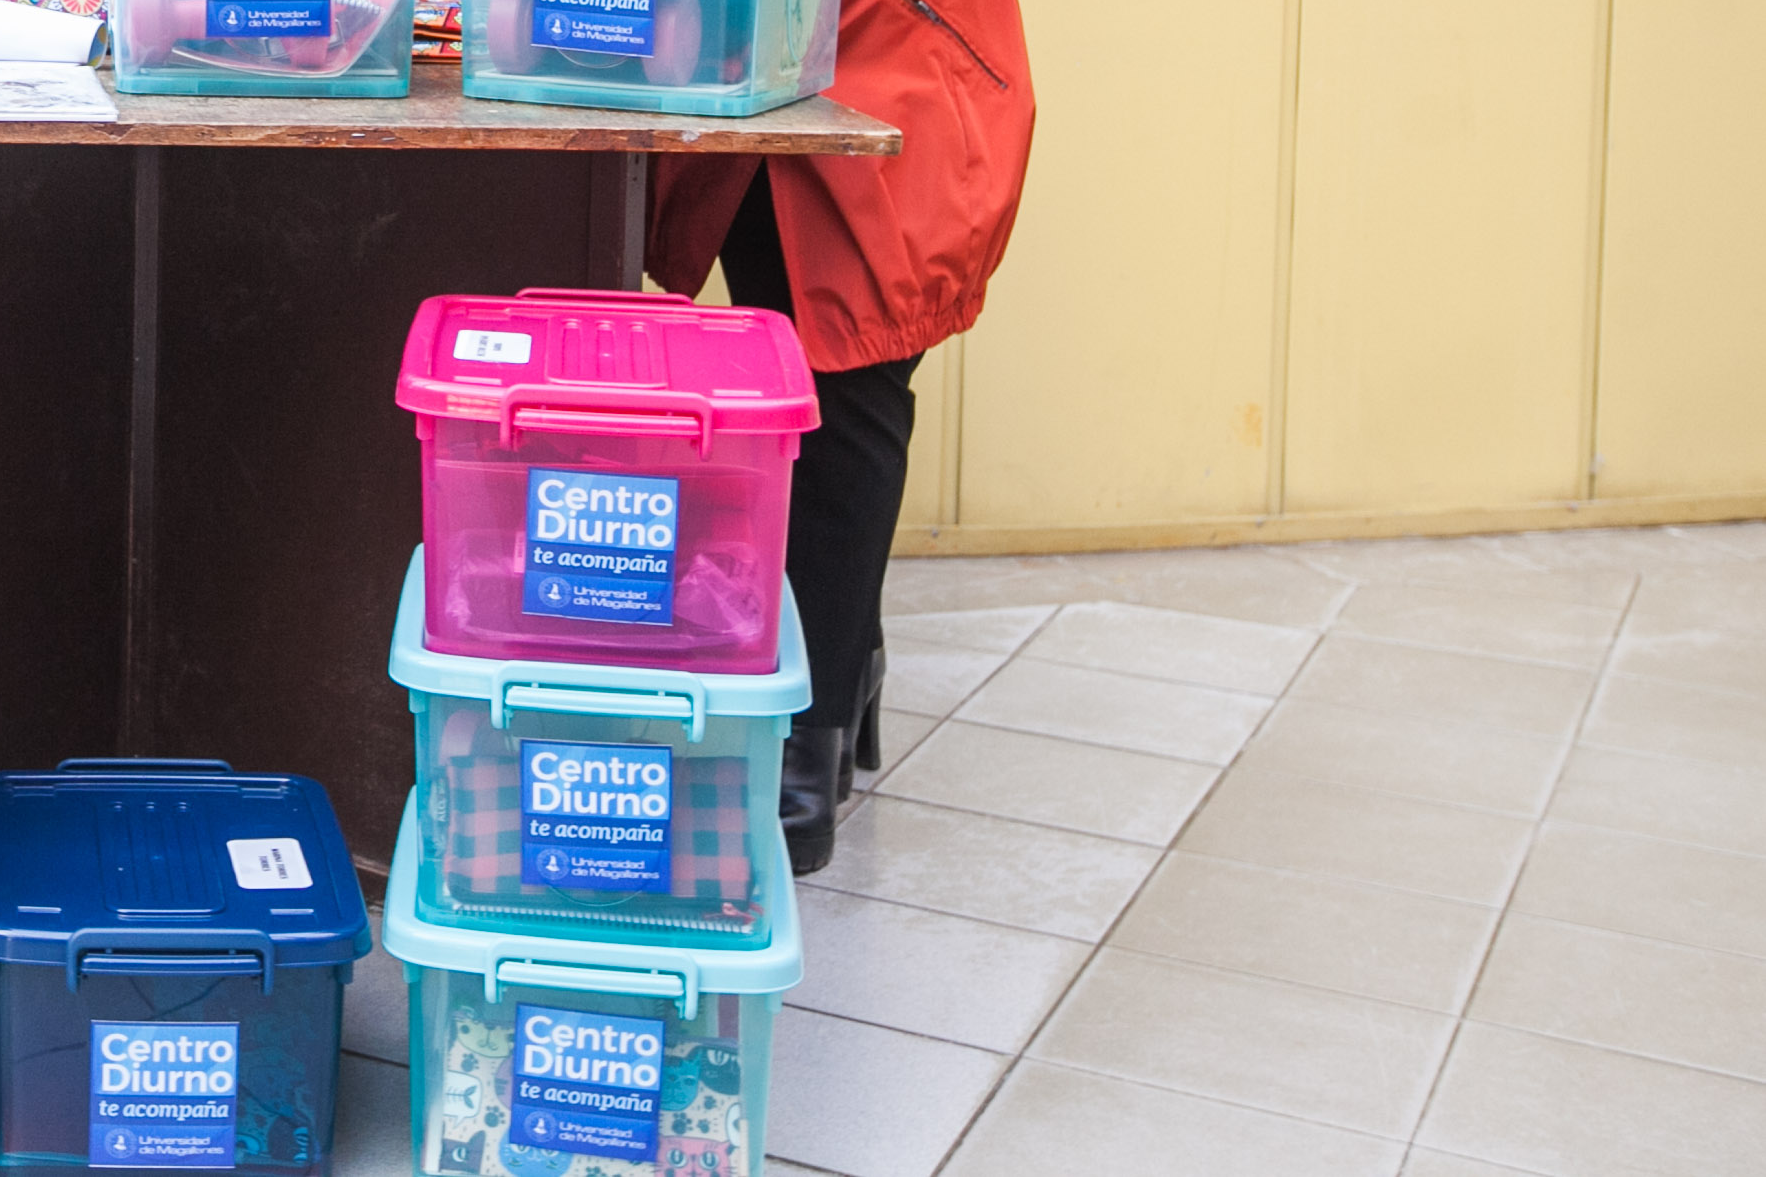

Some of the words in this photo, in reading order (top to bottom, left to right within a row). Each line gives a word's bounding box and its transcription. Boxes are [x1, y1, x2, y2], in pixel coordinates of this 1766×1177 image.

[537, 479, 673, 517] Centro
[537, 507, 673, 548] Diurno
[534, 547, 554, 565] te
[558, 550, 668, 574] acompaña
[531, 751, 667, 787] Centro
[531, 781, 667, 817] Diurno
[531, 819, 551, 836] te
[554, 822, 664, 844] acompaña
[101, 1033, 234, 1064] Centro
[524, 1015, 659, 1057] Centro
[102, 1062, 234, 1093] Diurno
[524, 1043, 658, 1088] Diurno
[99, 1100, 118, 1117] te
[123, 1096, 229, 1120] acompaña
[520, 1081, 540, 1101] te
[544, 1085, 654, 1113] acompaña
